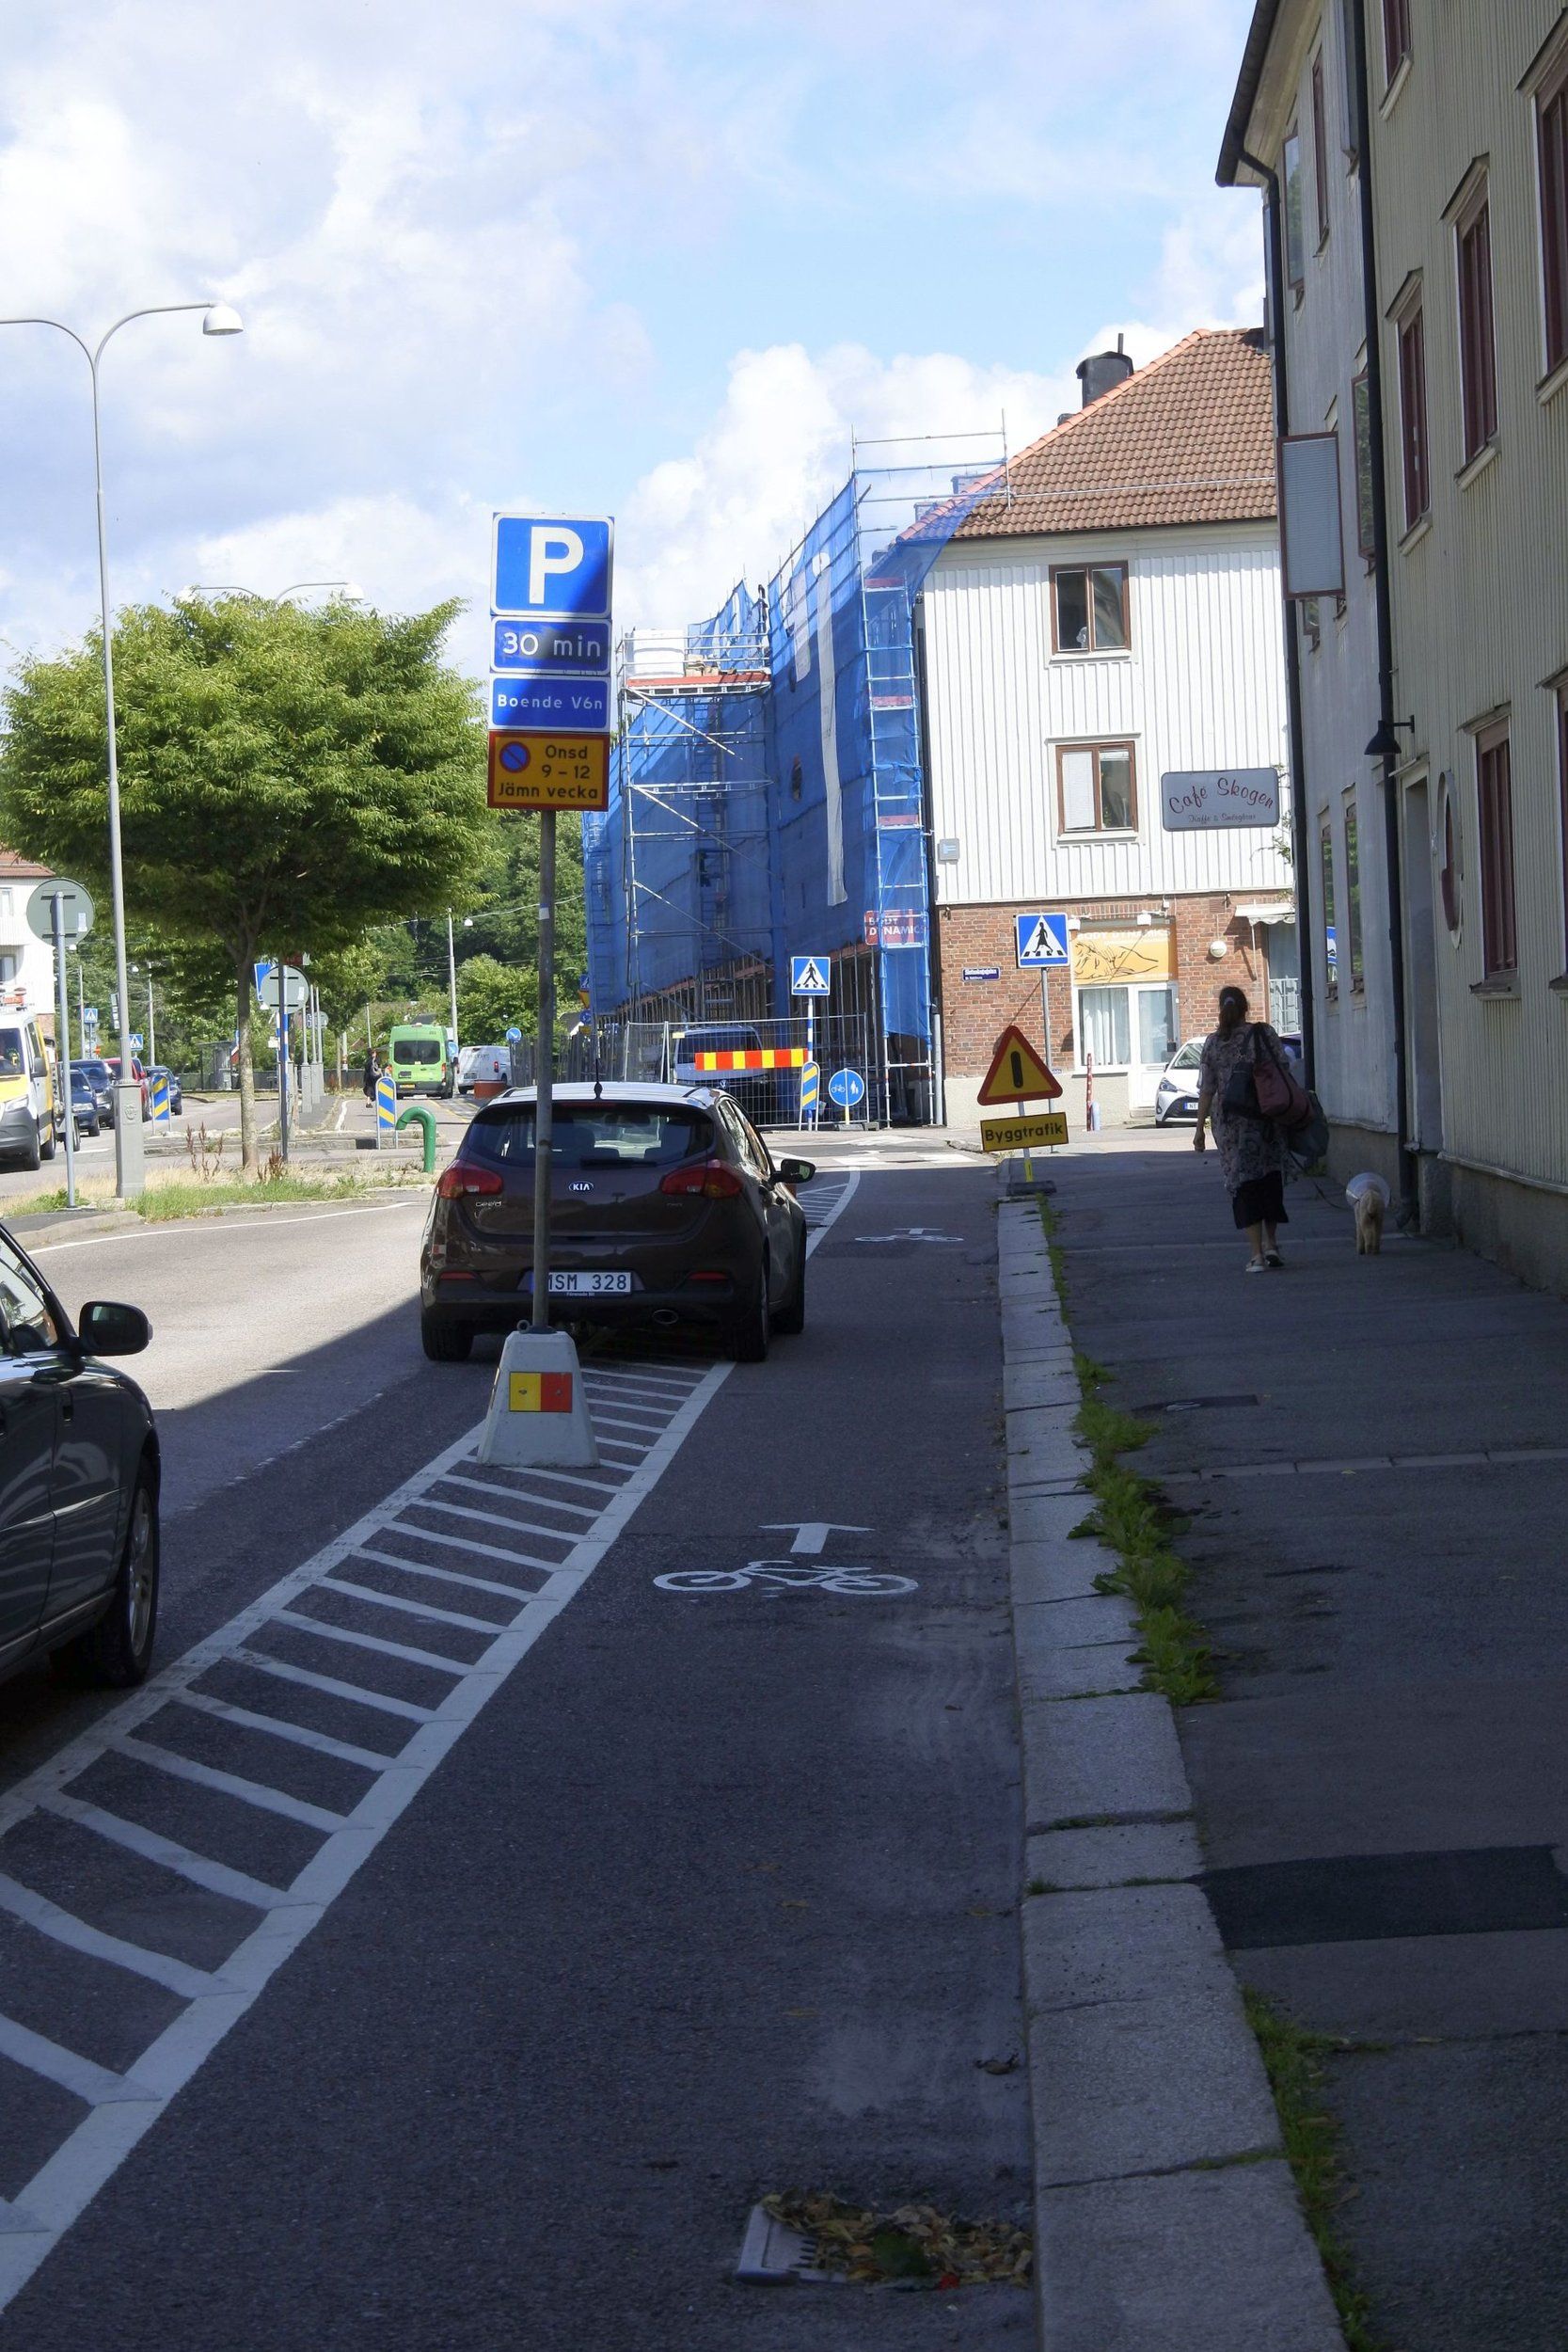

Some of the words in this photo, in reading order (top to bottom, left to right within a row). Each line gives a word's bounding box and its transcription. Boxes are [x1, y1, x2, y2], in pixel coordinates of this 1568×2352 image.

[529, 526, 584, 605] P
[502, 632, 539, 655] 30
[553, 635, 601, 657] min
[498, 694, 562, 708] Boende
[571, 697, 602, 709] V6n
[545, 744, 588, 759] Onsd
[541, 764, 552, 778] 9
[574, 766, 591, 779] 12
[499, 783, 540, 797] Jämn
[546, 785, 598, 800] vecka
[1217, 777, 1274, 809] Skogen
[985, 1122, 1064, 1143] Byggtrafik
[573, 1183, 591, 1191] KIA
[592, 1274, 626, 1290] 328
